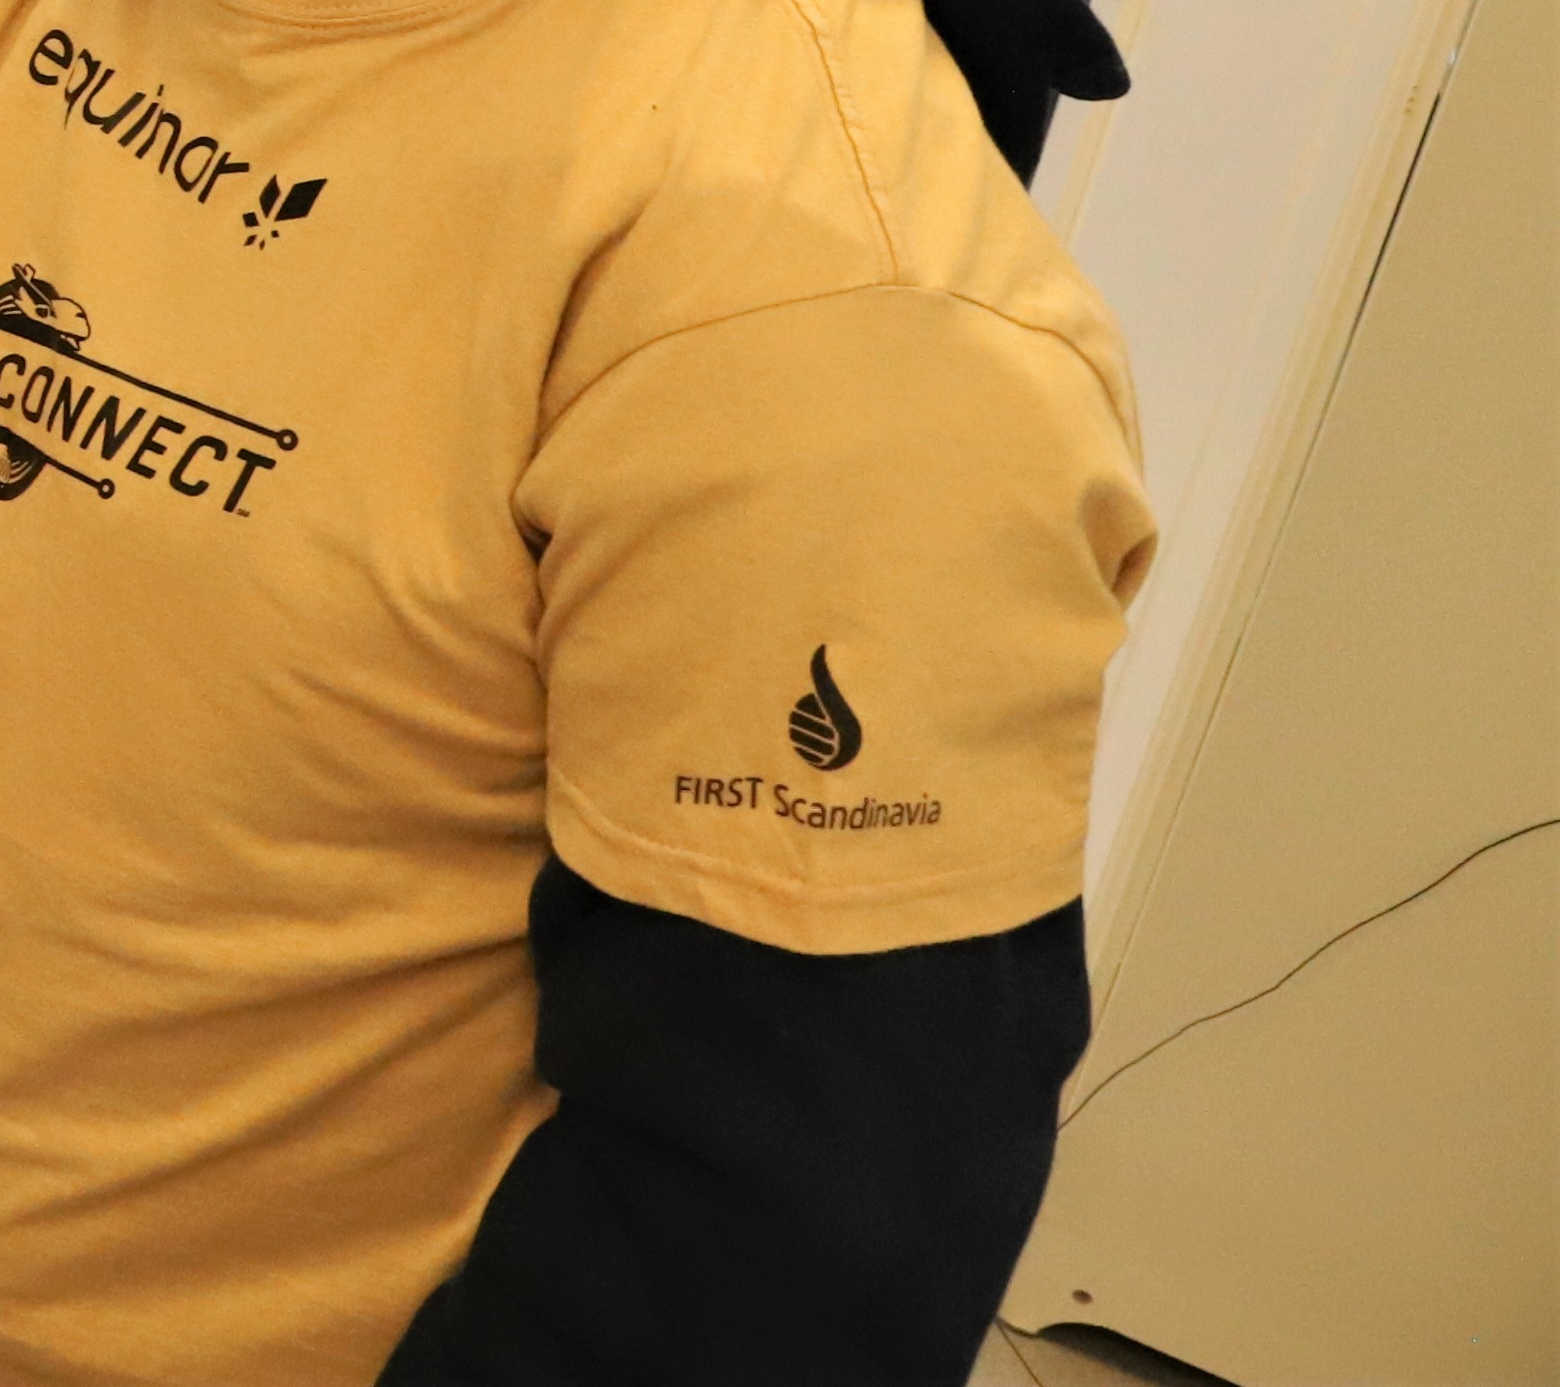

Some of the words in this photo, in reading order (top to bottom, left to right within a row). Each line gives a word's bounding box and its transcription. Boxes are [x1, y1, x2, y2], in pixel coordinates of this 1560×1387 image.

[27, 27, 251, 206] equinor
[674, 775, 764, 810] FIRST
[773, 783, 943, 830] Scandinavia
